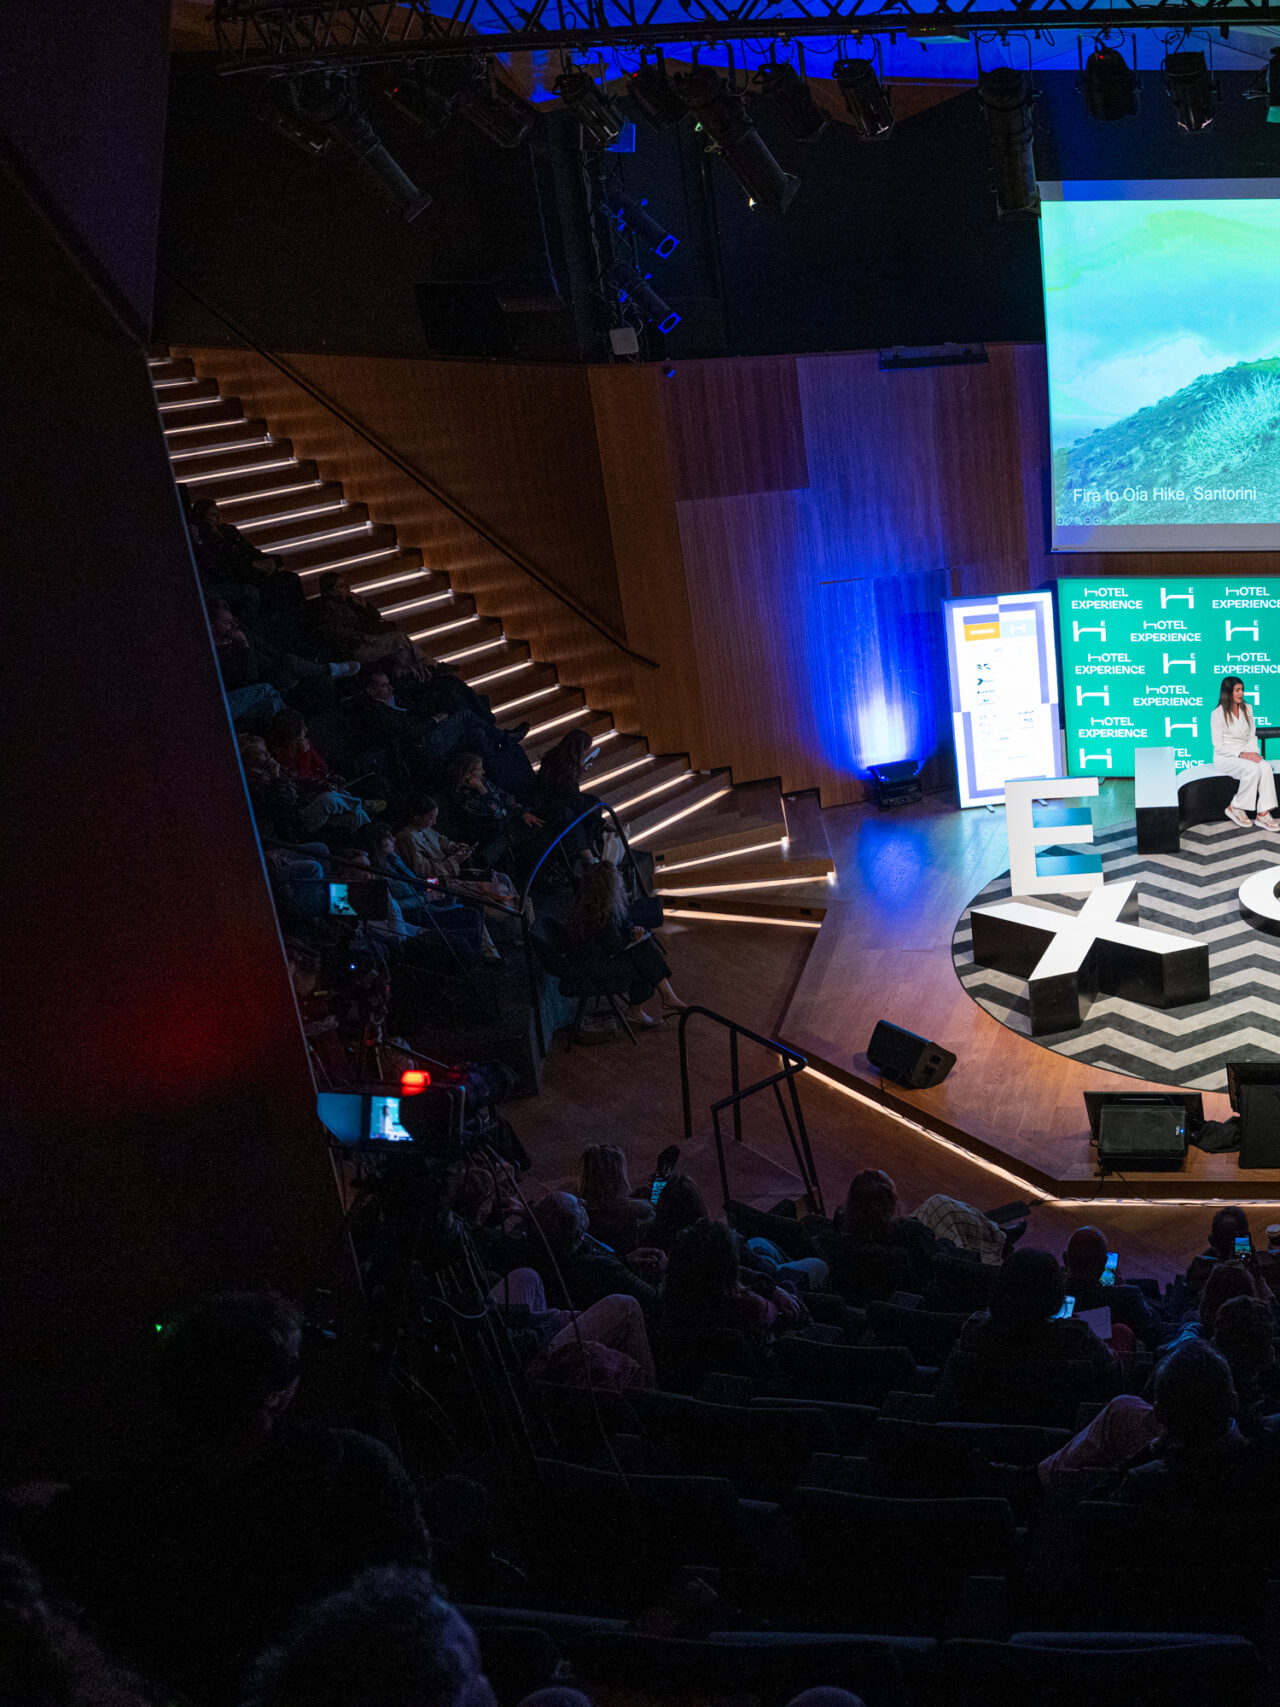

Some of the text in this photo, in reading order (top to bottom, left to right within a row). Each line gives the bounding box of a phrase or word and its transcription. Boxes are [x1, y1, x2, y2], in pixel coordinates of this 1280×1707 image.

[1073, 488, 1100, 502] Fira
[1105, 489, 1118, 502] to
[1153, 487, 1189, 503] Hike,
[1193, 486, 1257, 501] Santorini
[1083, 587, 1129, 598] HOTEL
[1225, 586, 1271, 597] HOTEL
[1071, 599, 1144, 610] EXPERIENCE
[1143, 620, 1188, 630] HOTEL
[1130, 632, 1202, 643] EXPERIENCE
[1087, 652, 1132, 663] HOTEL
[1226, 652, 1271, 662] HOTEL
[1074, 665, 1146, 675] EXPERIENCE
[1145, 684, 1190, 695] HOTEL
[1132, 696, 1204, 707] EXPERIENCE
[1090, 716, 1135, 727] HOTEL
[1078, 728, 1148, 738] EXPERIENCE
